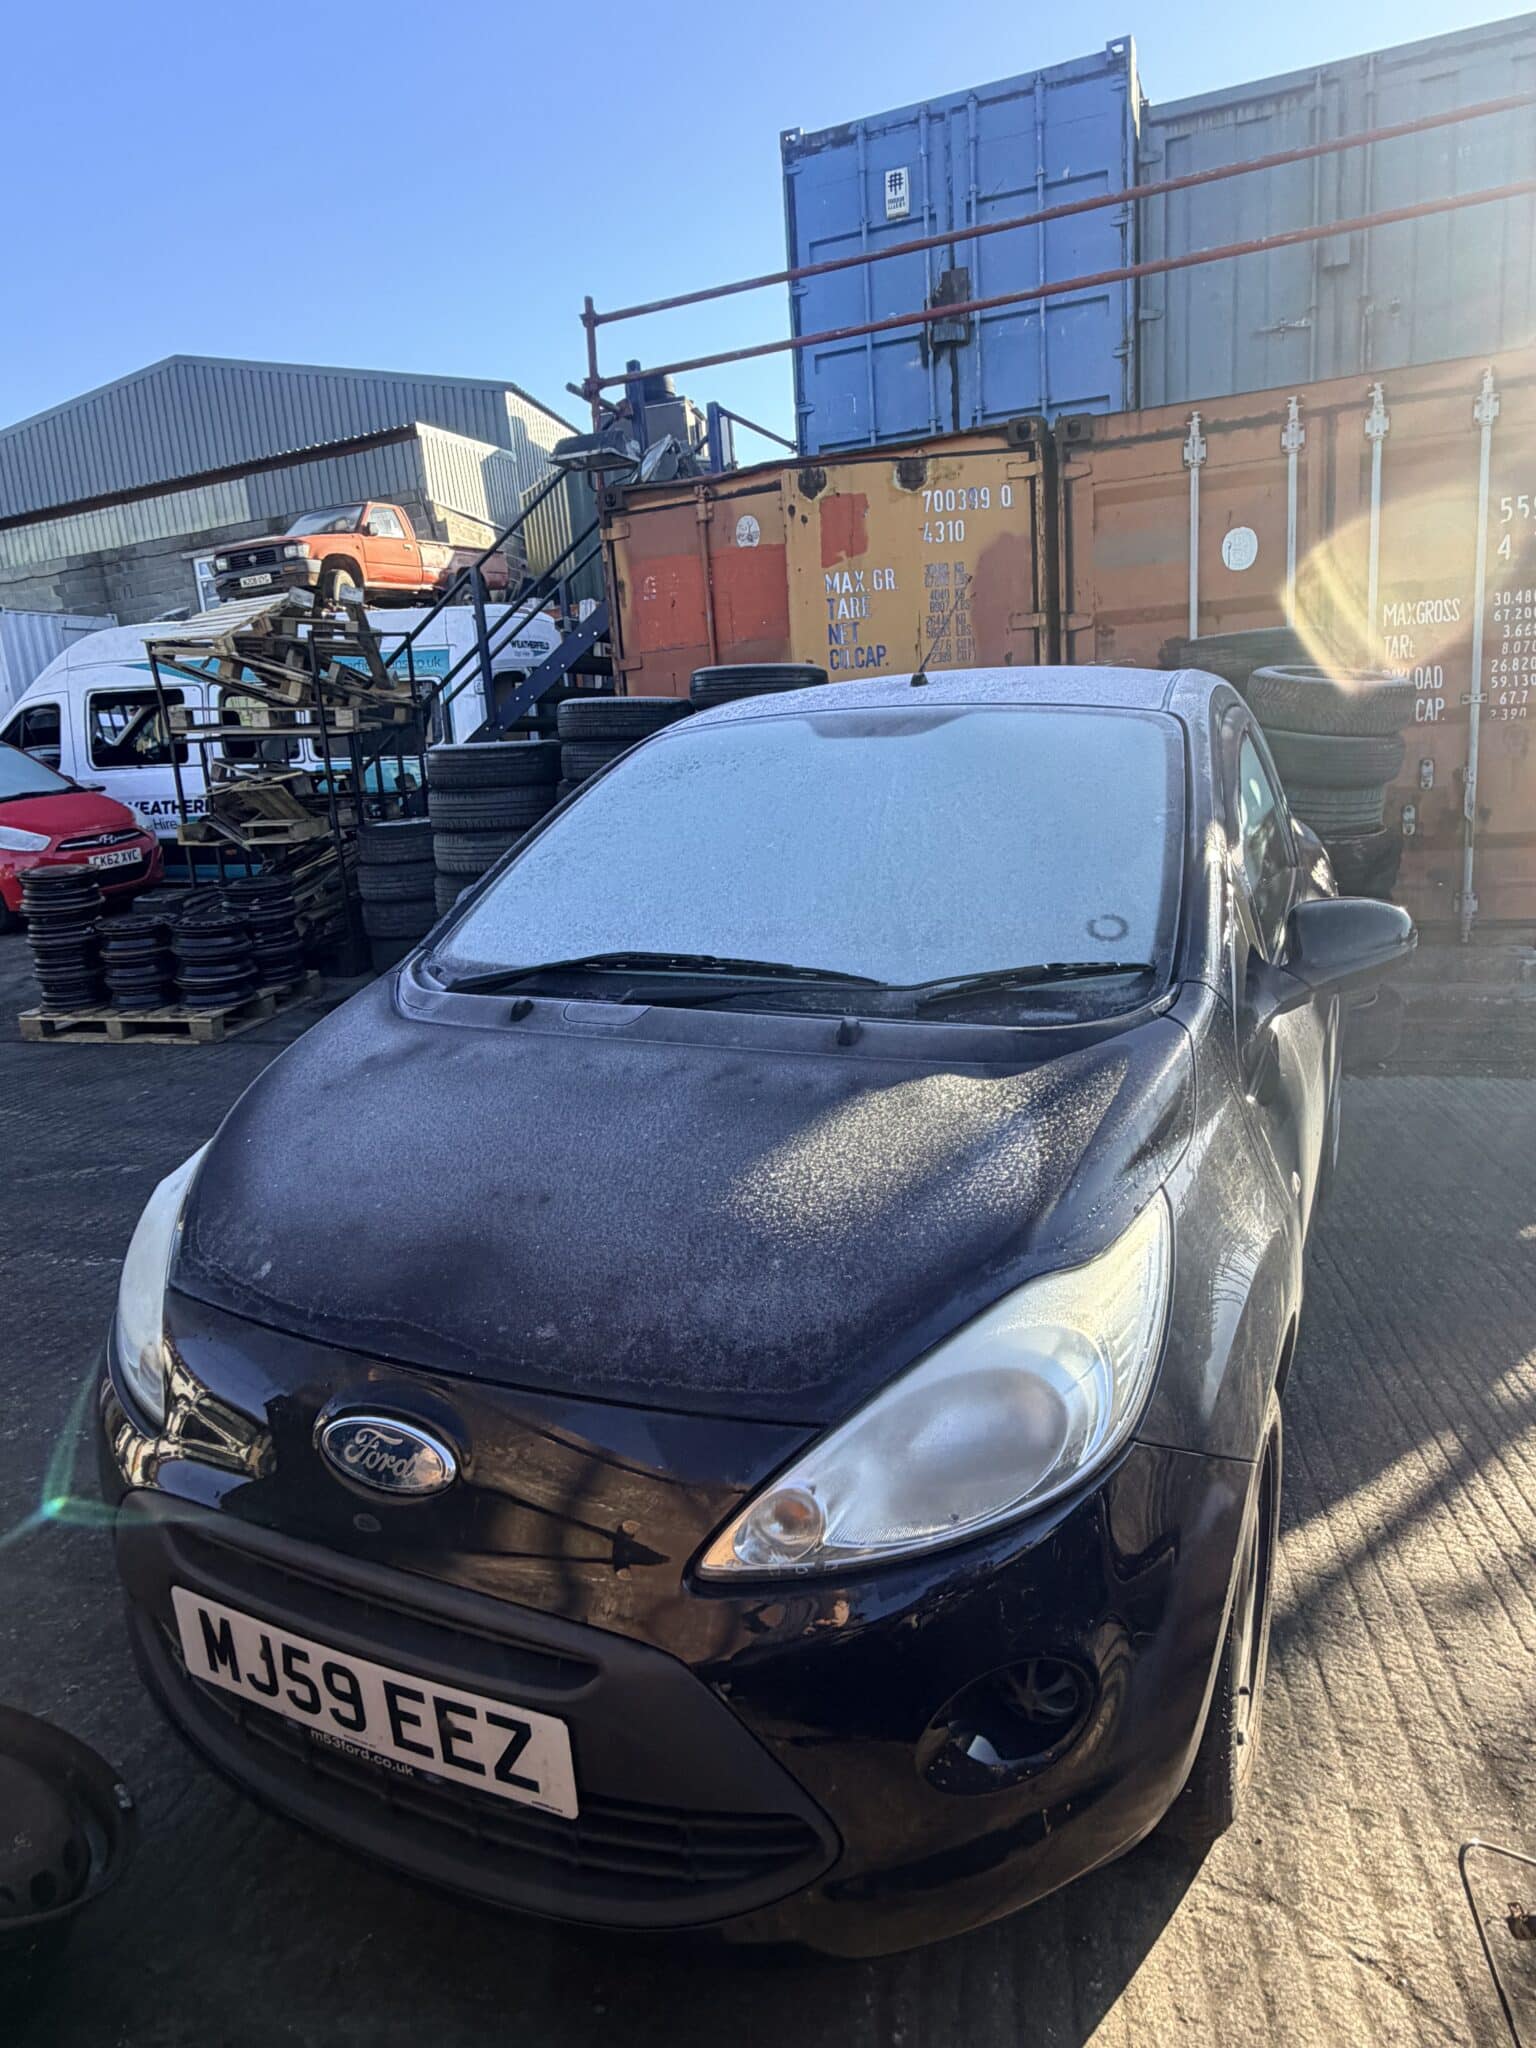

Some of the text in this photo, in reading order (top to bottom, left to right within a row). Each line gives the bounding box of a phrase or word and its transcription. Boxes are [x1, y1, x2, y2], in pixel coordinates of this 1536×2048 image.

[1001, 484, 1013, 508] 0
[1500, 494, 1536, 524] 55
[923, 519, 965, 544] 4310
[827, 595, 871, 620] TARE
[1494, 590, 1536, 606] 30.48
[1494, 607, 1536, 622] 67.20
[828, 621, 860, 646] NET
[153, 816, 178, 831] Hire
[121, 849, 139, 863] XVC
[344, 1428, 418, 1477] Ford
[198, 1608, 540, 1794] MJ59 EEZ
